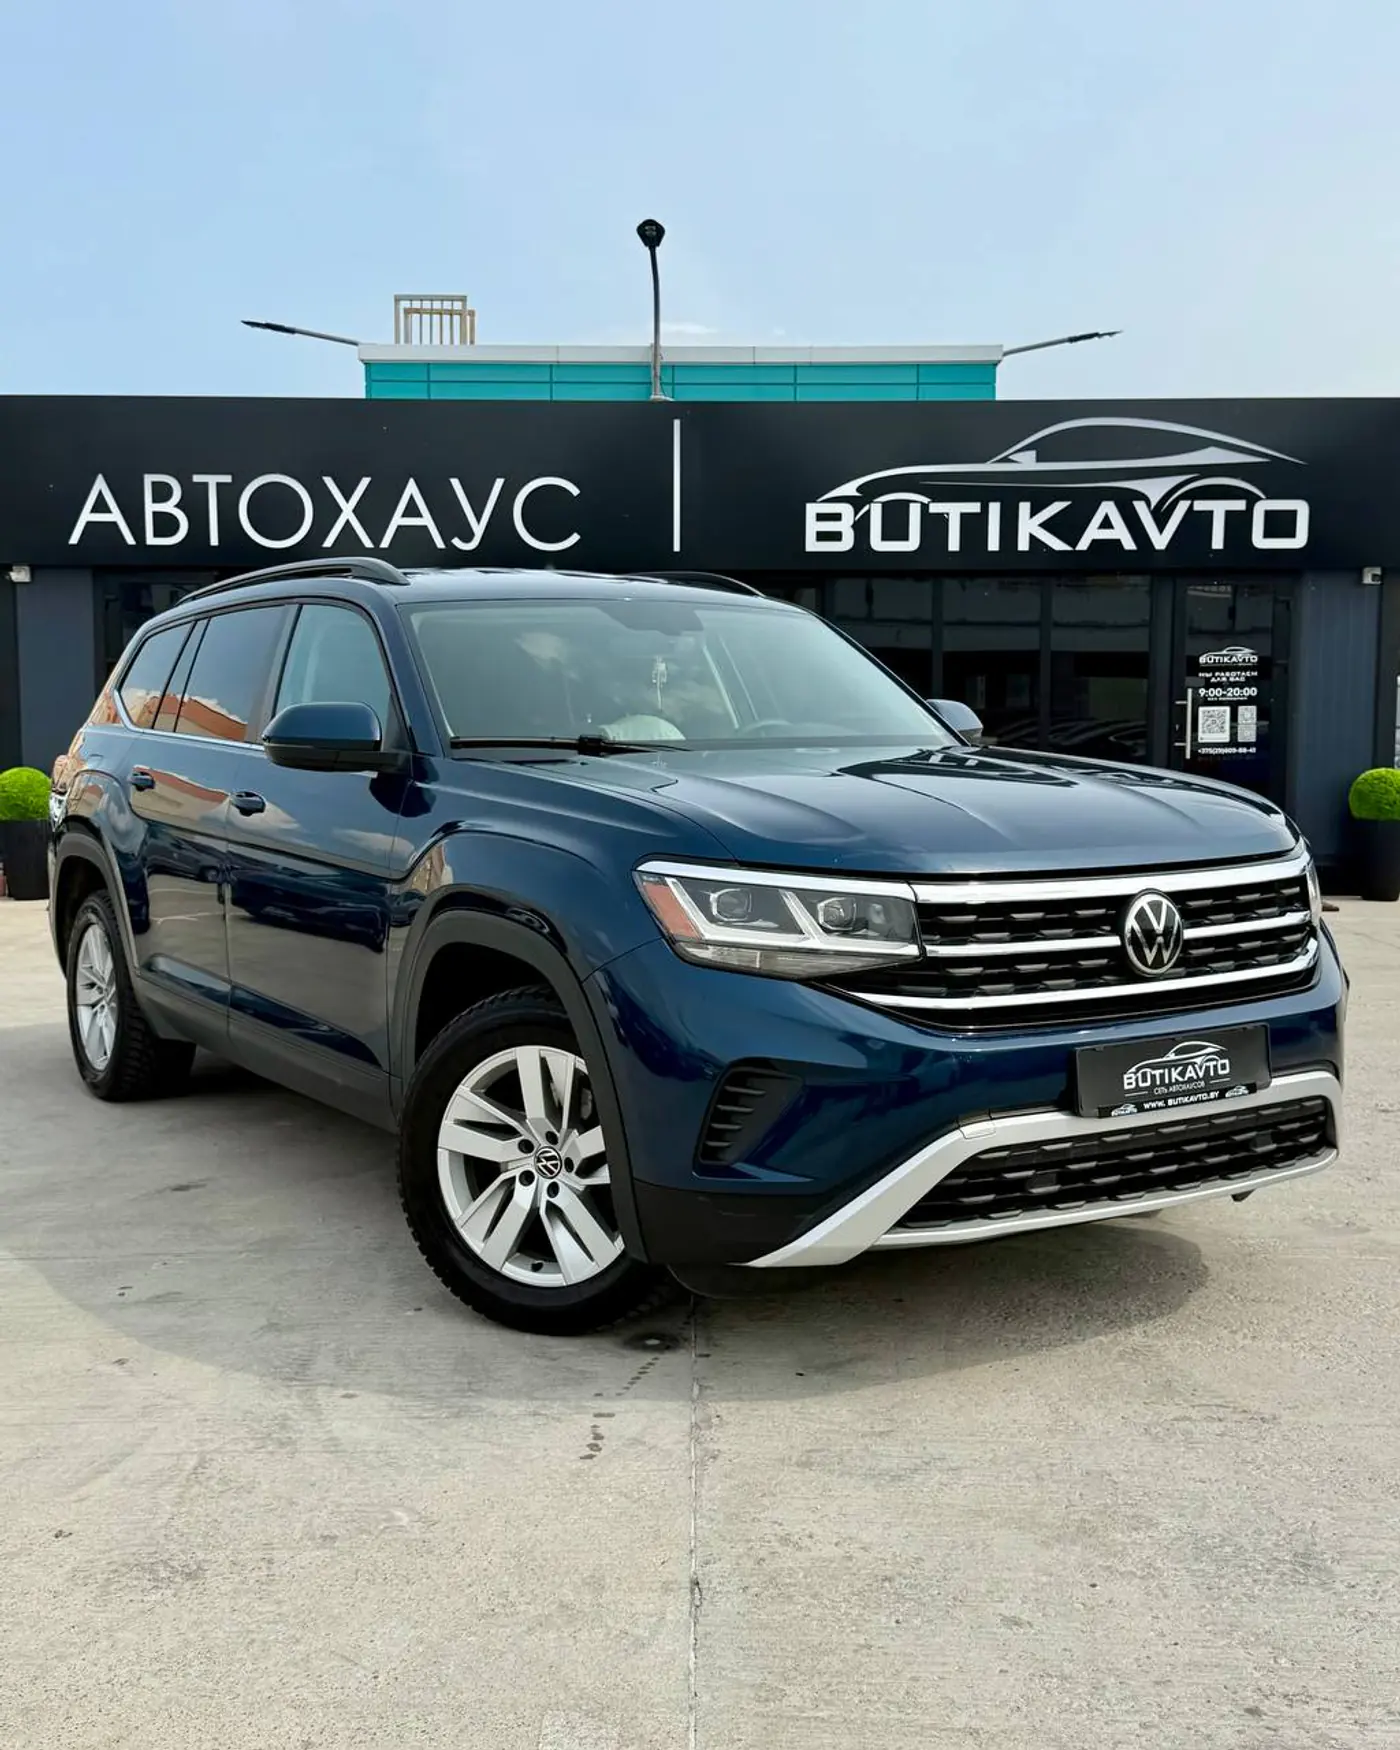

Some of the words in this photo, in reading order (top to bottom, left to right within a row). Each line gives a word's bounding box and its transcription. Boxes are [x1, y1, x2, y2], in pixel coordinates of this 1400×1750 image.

[68, 473, 581, 551] АВТОХАУС
[805, 500, 1310, 553] BUTIKAVTO
[1199, 655, 1258, 664] BUTIKAVTO
[1199, 687, 1258, 697] 9:00-20:00
[1123, 1059, 1230, 1090] BUTIKAVTO
[1167, 1090, 1220, 1106] BUTIKAVTO.BY
